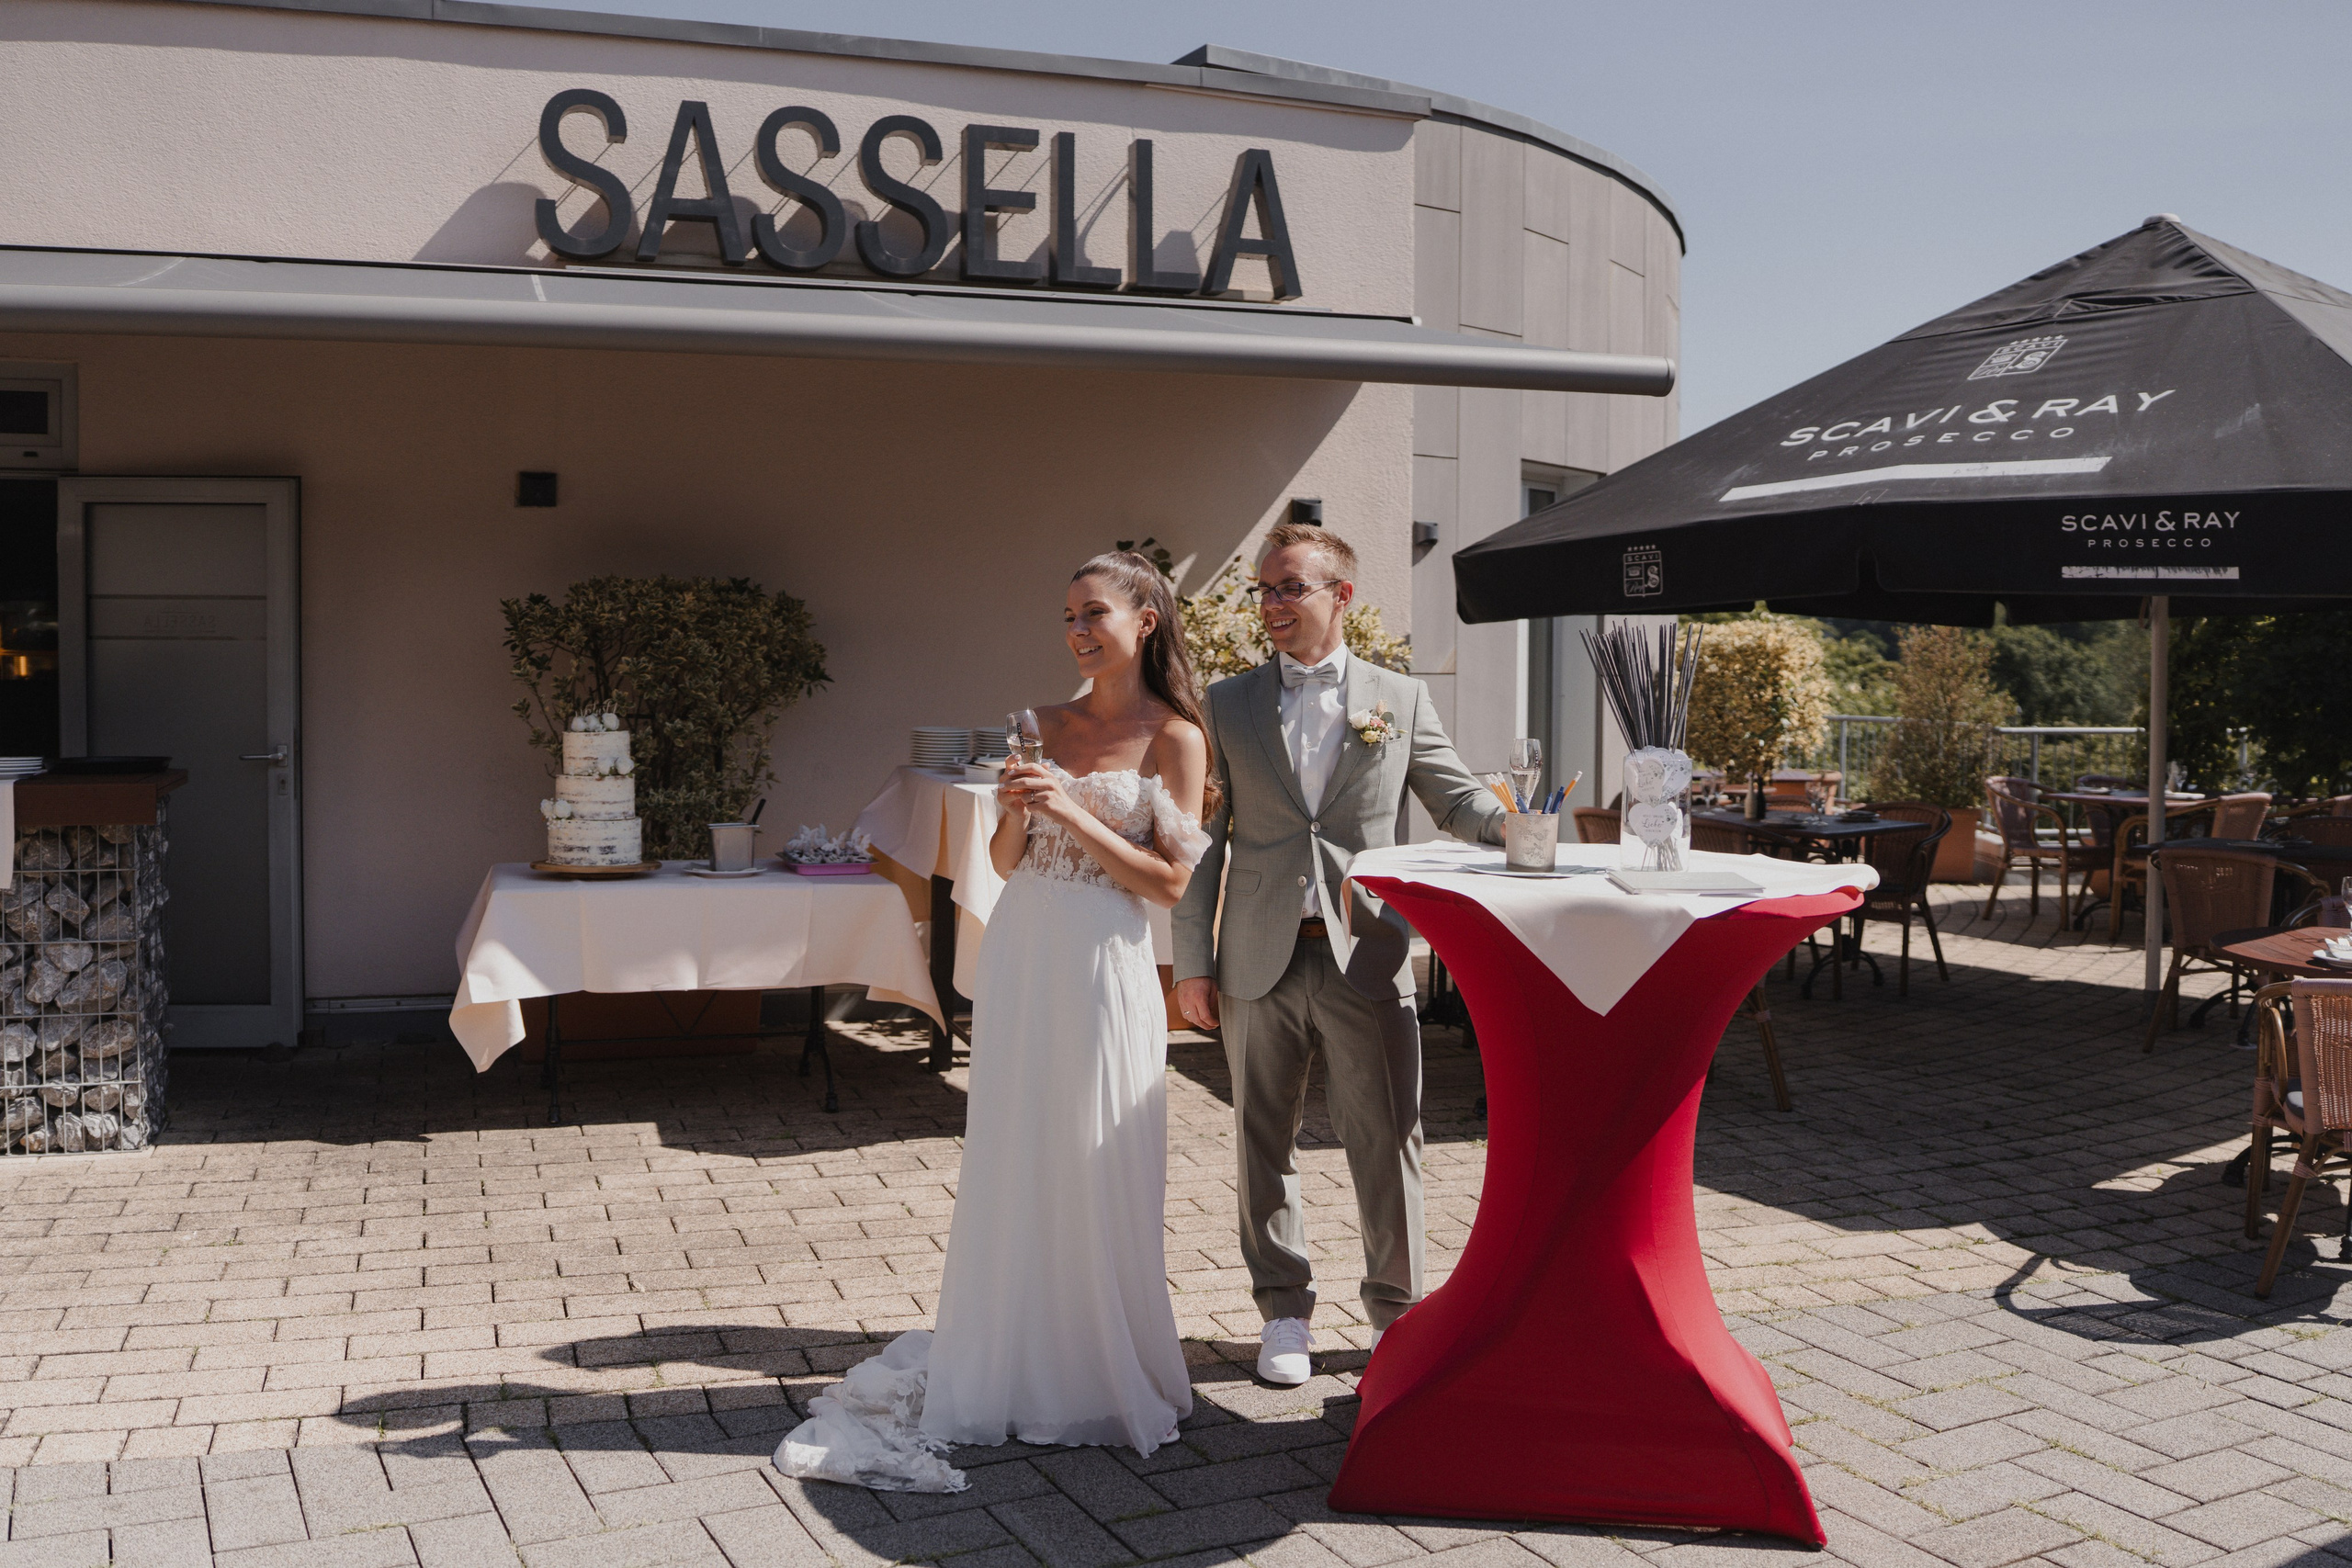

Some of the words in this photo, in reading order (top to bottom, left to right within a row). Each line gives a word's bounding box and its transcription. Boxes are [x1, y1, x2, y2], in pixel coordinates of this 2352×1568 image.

[535, 88, 1303, 301] SASSELLA
[1807, 427, 2075, 460] PROSECCO
[2087, 538, 2211, 548] PROSECCO
